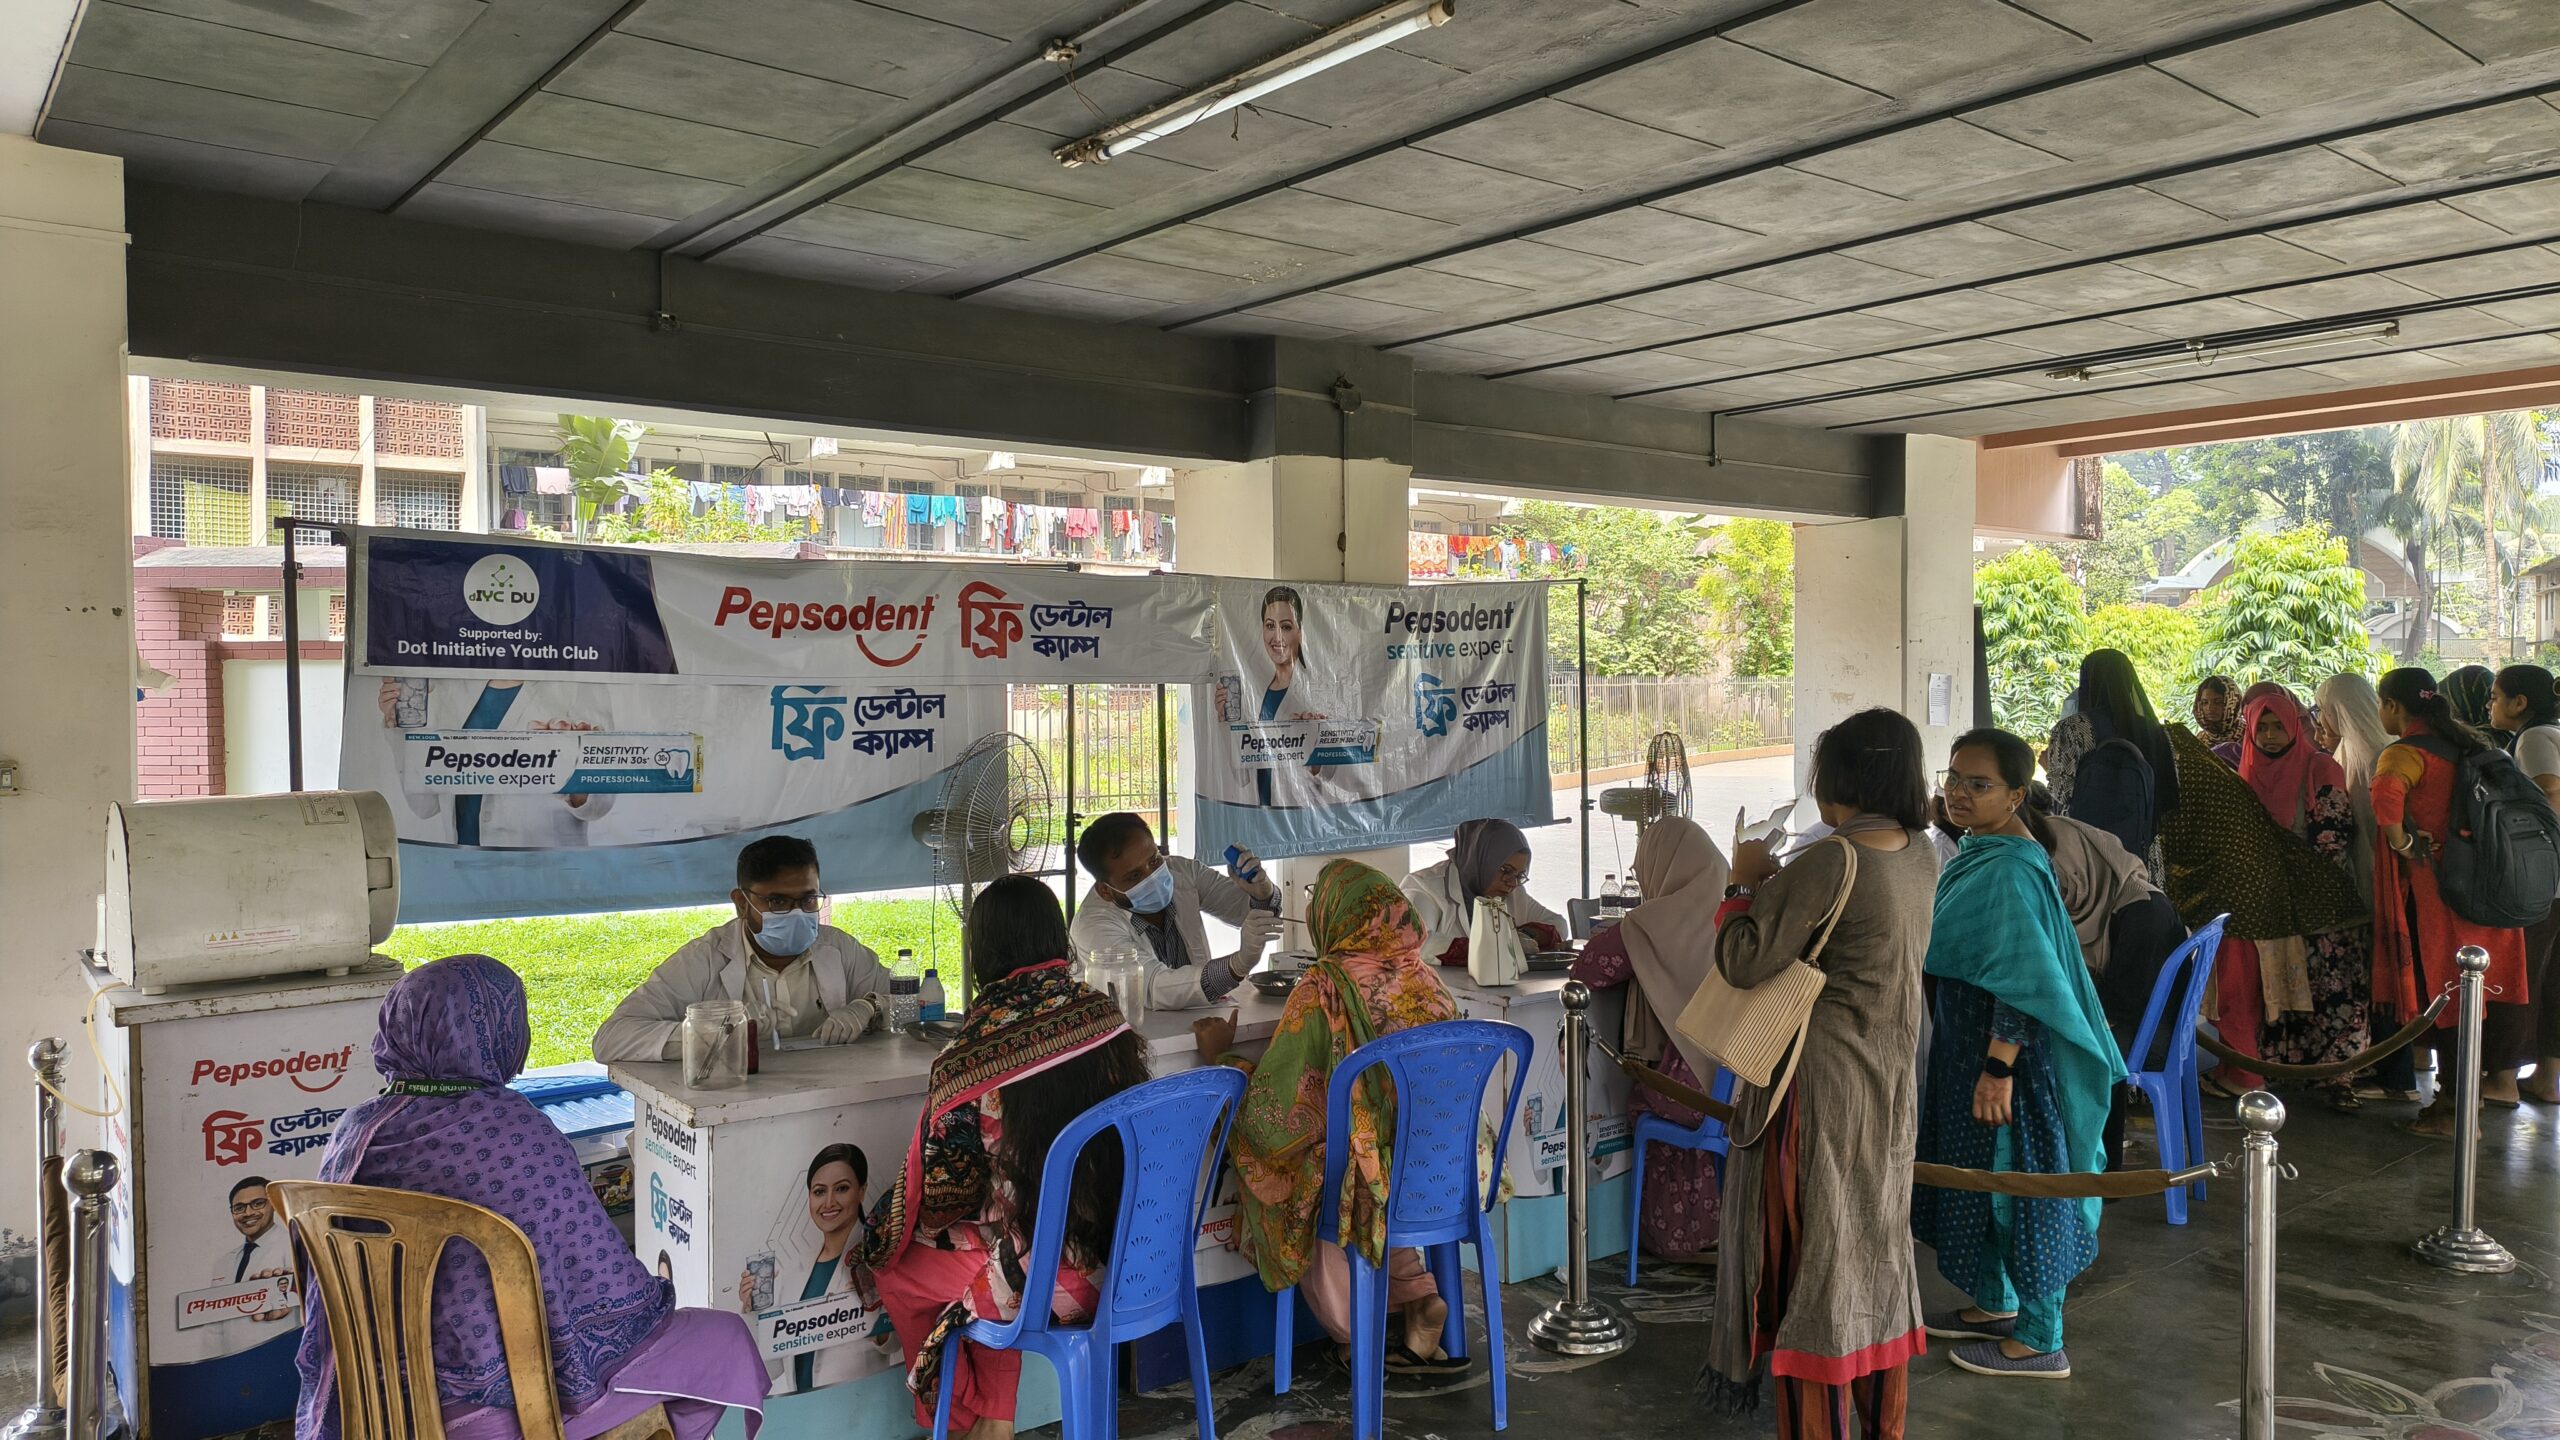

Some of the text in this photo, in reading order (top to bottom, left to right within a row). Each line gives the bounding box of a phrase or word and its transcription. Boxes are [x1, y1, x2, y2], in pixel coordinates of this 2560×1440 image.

[511, 591, 535, 604] DU
[714, 586, 937, 639] Pepsodent
[958, 581, 1113, 659] ফ্রি ডেন্টাল
[1384, 601, 1515, 640] Pepsodent
[459, 627, 543, 641] Supported by:
[1030, 635, 1100, 662] ক্যাম্প
[398, 640, 599, 661] Dot Initiative Youth Club
[1386, 638, 1514, 660] sensitive expert
[1413, 672, 1458, 738] ফ্রি
[770, 685, 946, 761] ফ্রি ডেন্টাল
[1463, 709, 1510, 734] ক্যাম্প
[425, 745, 558, 772] Pepsodent
[582, 746, 649, 755] SENSITIVITY
[852, 728, 935, 760] ক্যাম্প
[1278, 750, 1304, 762] expert
[582, 756, 617, 765] RELIEF
[617, 756, 628, 764] IN
[424, 771, 556, 788] sensitive expert
[581, 775, 650, 783] PROFESSIONAL
[191, 1045, 353, 1087] Pepsodent
[408, 1084, 429, 1093] Dhaka
[202, 1110, 265, 1166] ফ্রি
[645, 1102, 697, 1156] Pepsodent
[645, 1137, 697, 1180] sensitive expert
[650, 1171, 693, 1233] ফ্রি ডেন্টাল
[668, 1220, 690, 1251] ক্যাম্প
[187, 1288, 269, 1314] পেপসোডেন্ট
[773, 1305, 865, 1338] Pepsodent
[773, 1333, 824, 1352] sensitive
[826, 1321, 867, 1339] expert
